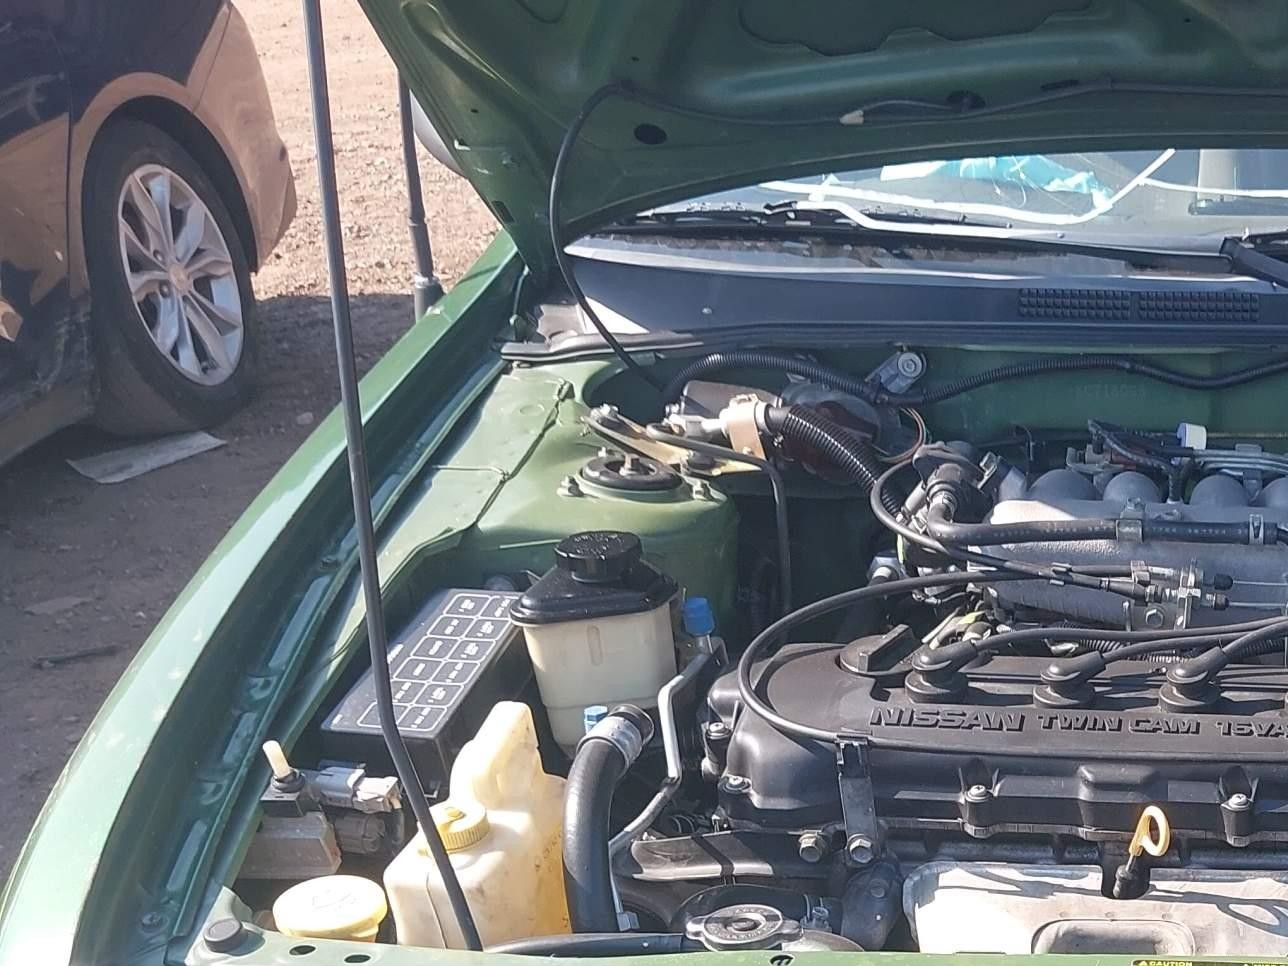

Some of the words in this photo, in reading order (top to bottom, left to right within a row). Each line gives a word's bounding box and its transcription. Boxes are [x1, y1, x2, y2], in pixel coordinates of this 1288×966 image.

[870, 706, 1025, 732] NISSAN
[1038, 713, 1123, 731] TWIN
[1129, 718, 1201, 735] CAM
